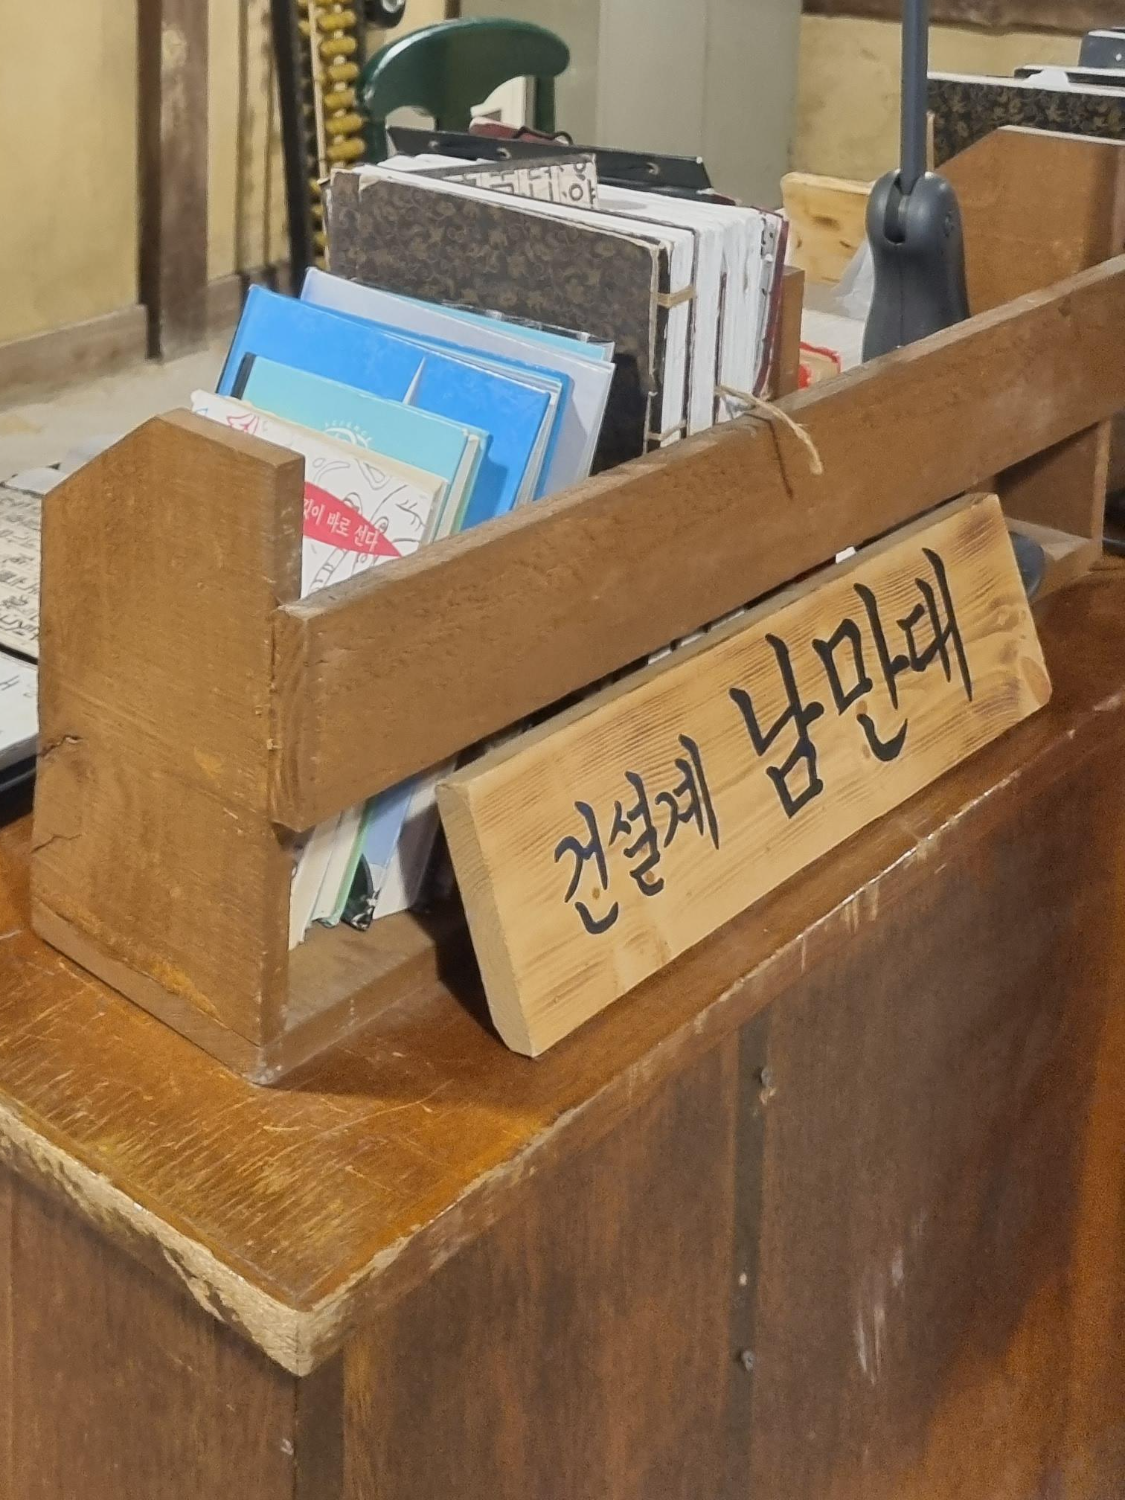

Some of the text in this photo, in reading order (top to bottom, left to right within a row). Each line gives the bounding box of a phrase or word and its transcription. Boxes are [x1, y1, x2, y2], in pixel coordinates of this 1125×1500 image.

[327, 511, 351, 537] 바로
[355, 524, 379, 553] 선다
[554, 548, 974, 935] 건설계 남만대
